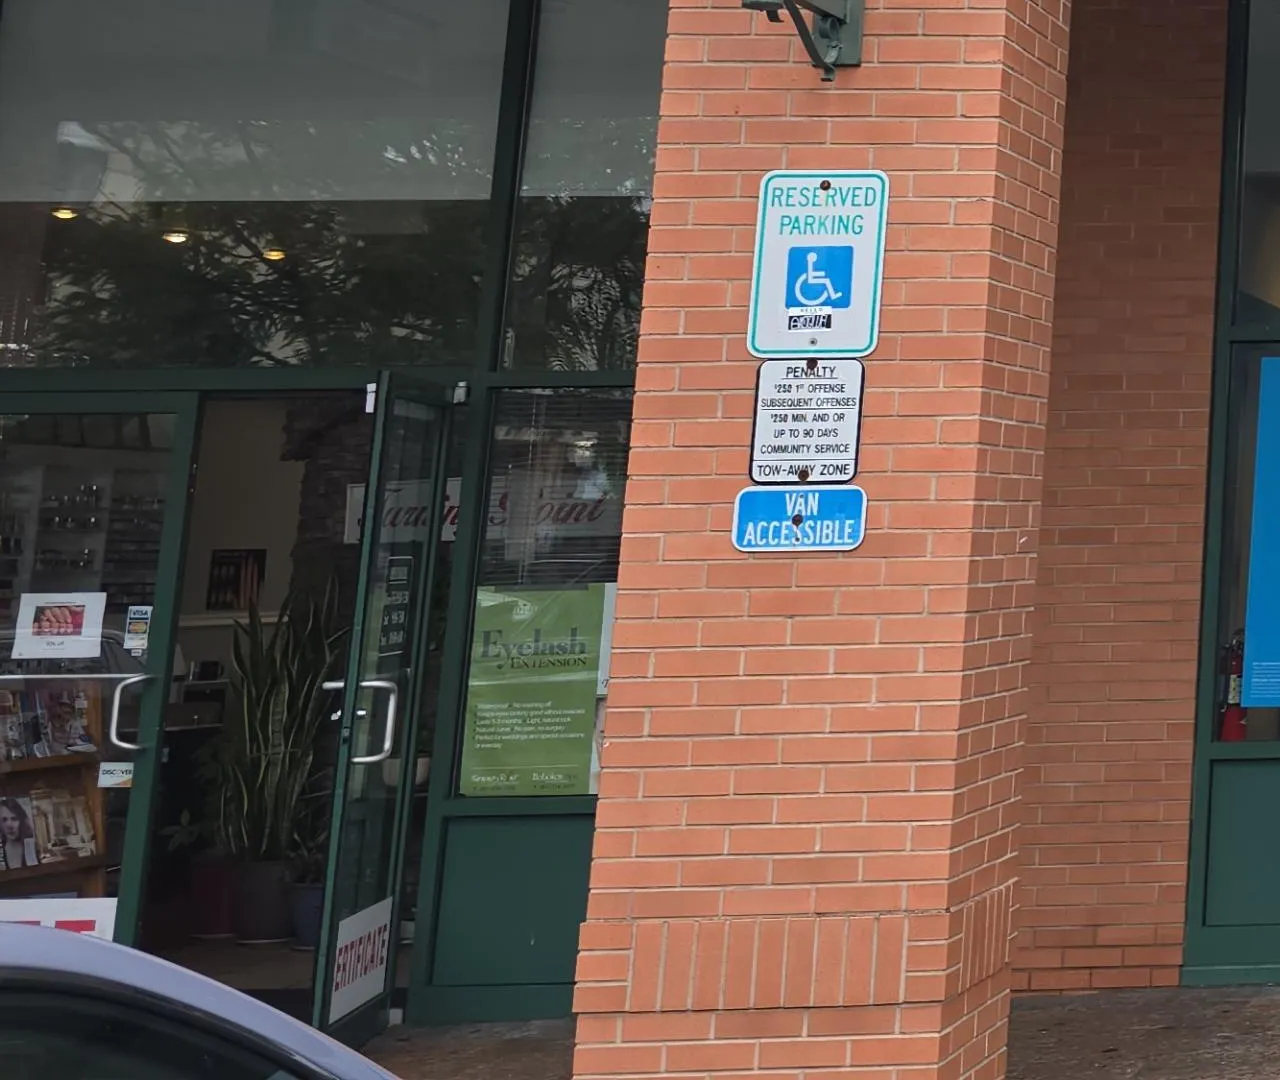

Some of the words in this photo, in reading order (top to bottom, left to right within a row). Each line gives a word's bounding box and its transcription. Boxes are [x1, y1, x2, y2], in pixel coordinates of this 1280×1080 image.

[771, 187, 877, 208] RESERVED
[778, 214, 864, 236] PARKING
[786, 367, 837, 378] PENALTY
[807, 384, 846, 393] OFFENSE
[760, 398, 813, 408] SUBSEQUENT
[815, 397, 857, 407] OFFENSES
[811, 414, 830, 422] AND
[832, 413, 846, 422] OR
[773, 429, 786, 439] UP
[788, 429, 800, 438] TO
[802, 428, 814, 438] 90
[817, 428, 839, 438] DAYS
[760, 444, 812, 455] COMMUNITY
[814, 443, 851, 454] SERVICE
[757, 464, 816, 477] TOW-AWAY
[819, 464, 851, 476] ZONE
[785, 492, 820, 516] VAN
[743, 519, 856, 546] ACCESSIBLE
[480, 626, 588, 670] Eyelash
[510, 657, 588, 670] EXTENSION
